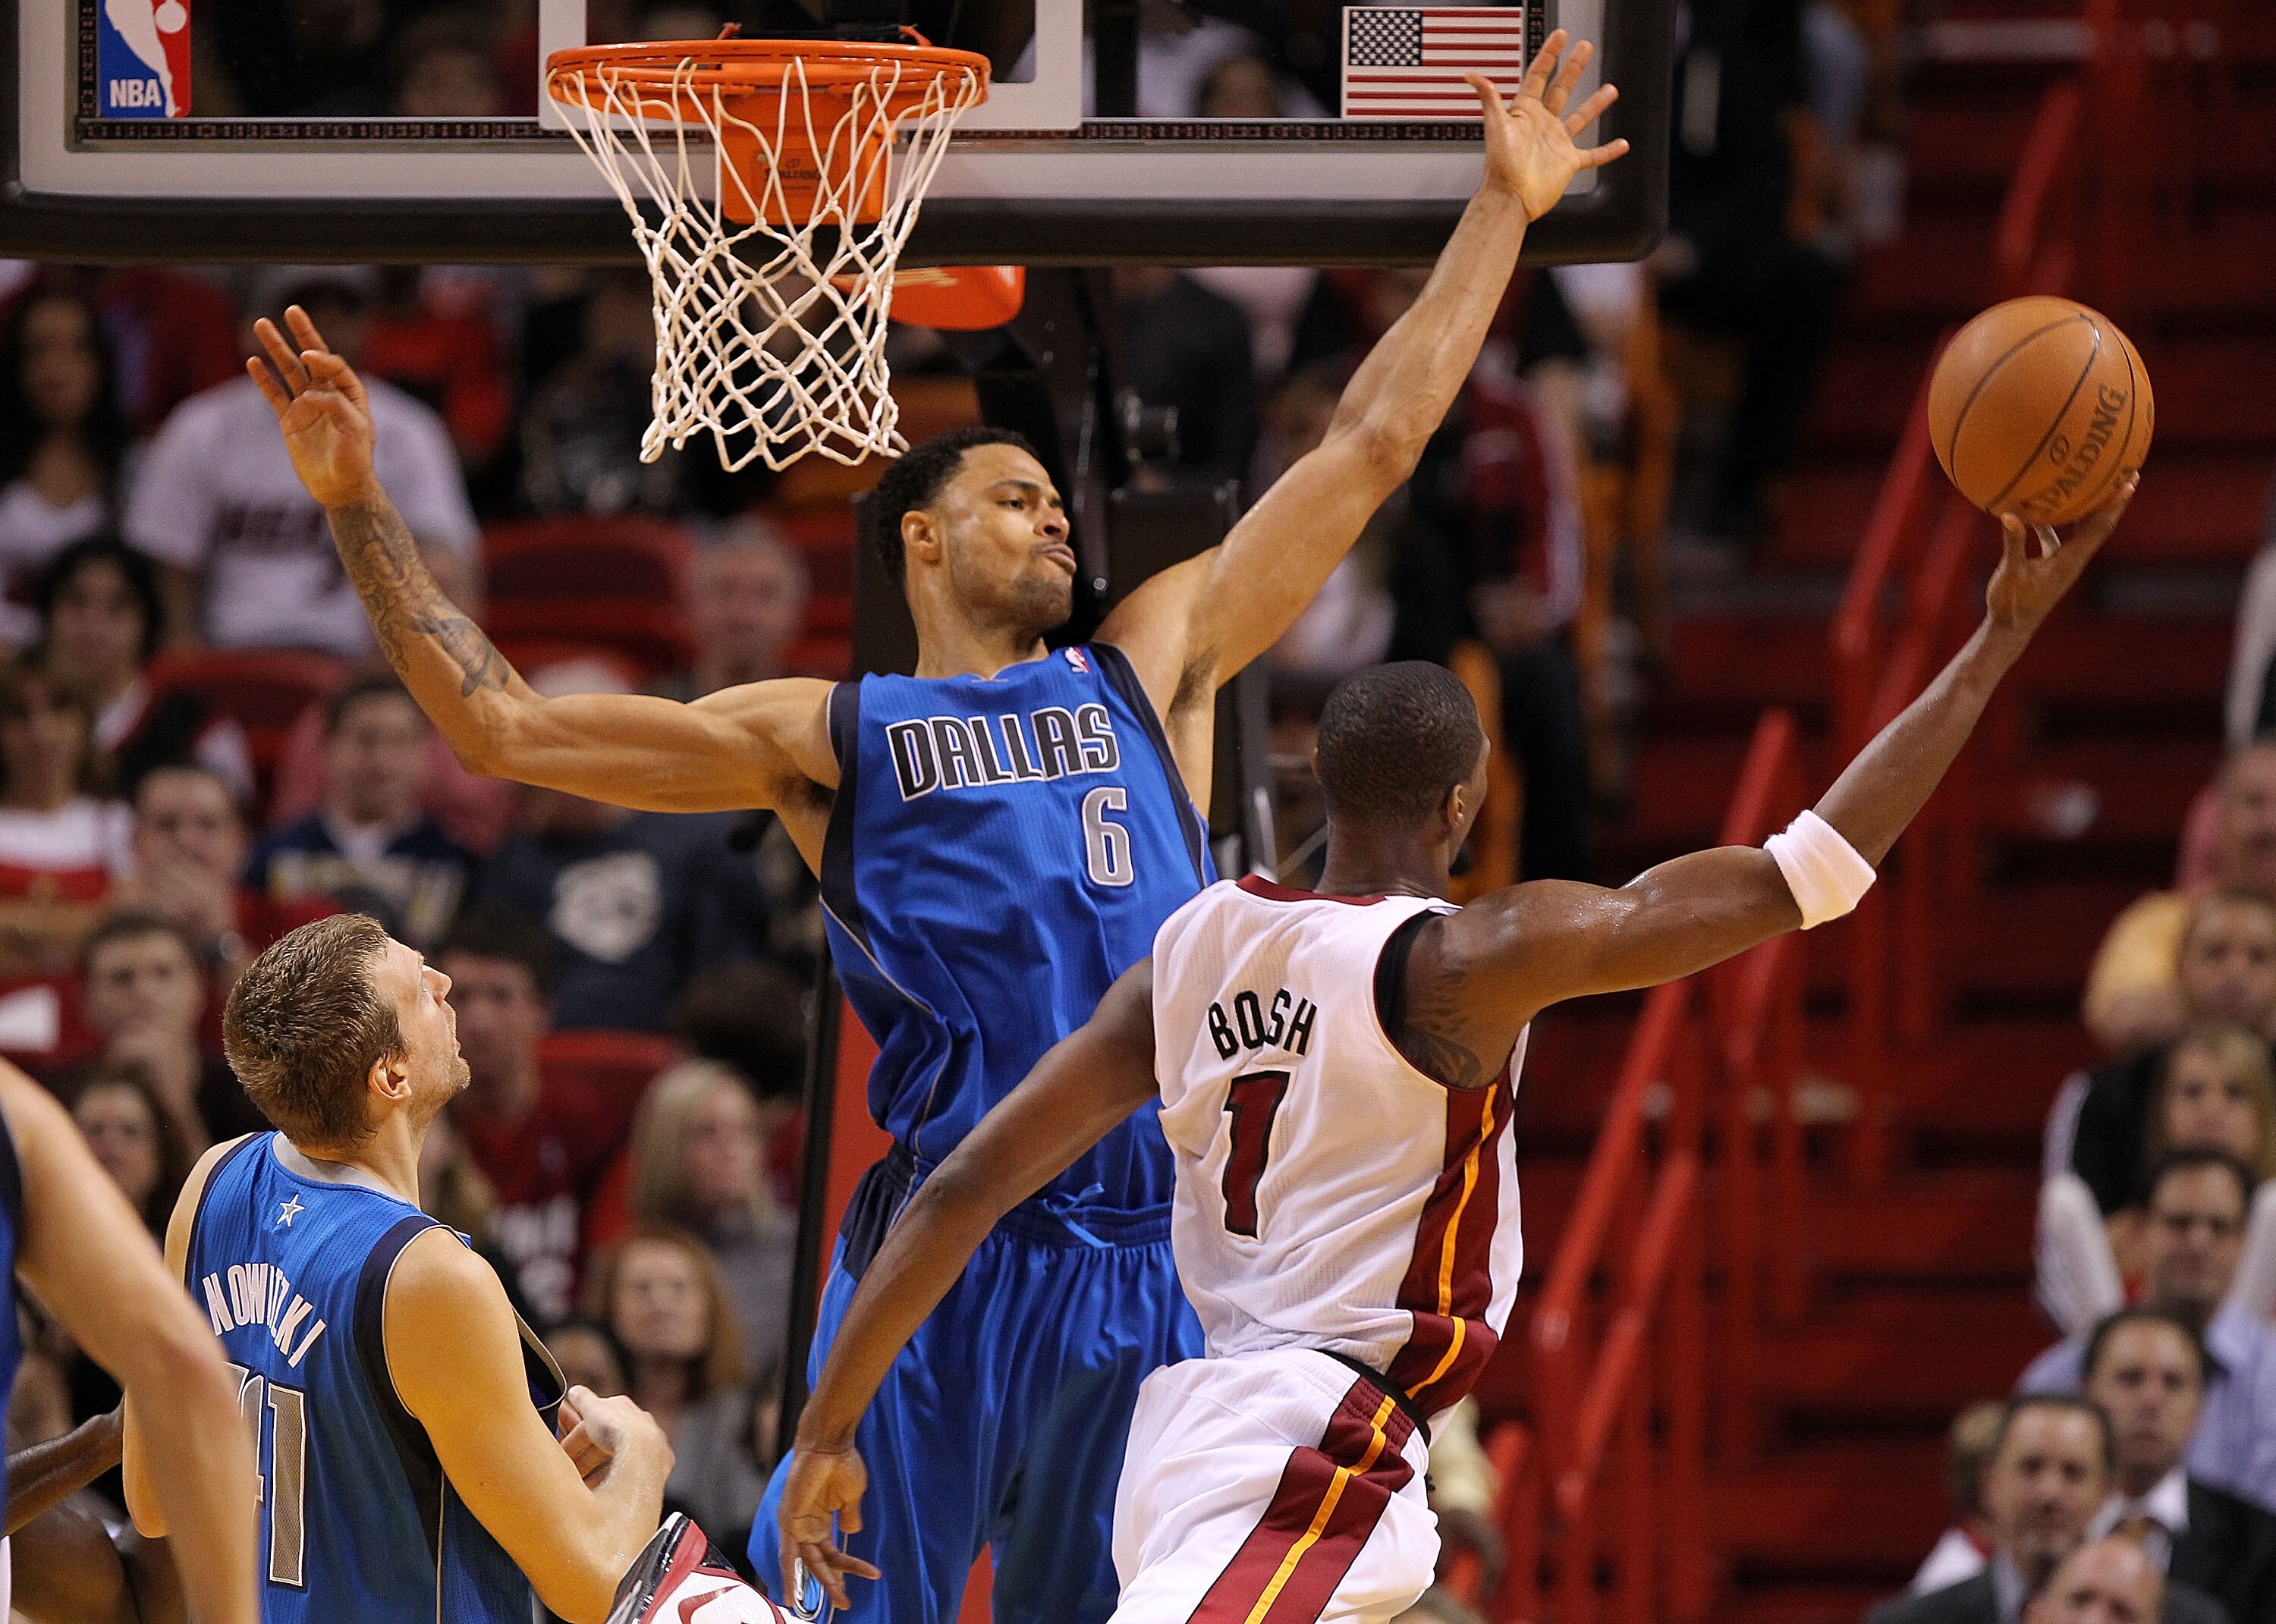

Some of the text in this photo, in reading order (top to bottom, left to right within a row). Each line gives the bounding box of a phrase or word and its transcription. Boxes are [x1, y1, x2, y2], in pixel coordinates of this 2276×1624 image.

[109, 78, 162, 108] NBA
[885, 702, 1121, 802] DALLAS
[1082, 786, 1134, 887] 6
[1208, 988, 1317, 1061] BOSH
[1221, 1068, 1291, 1240] 1
